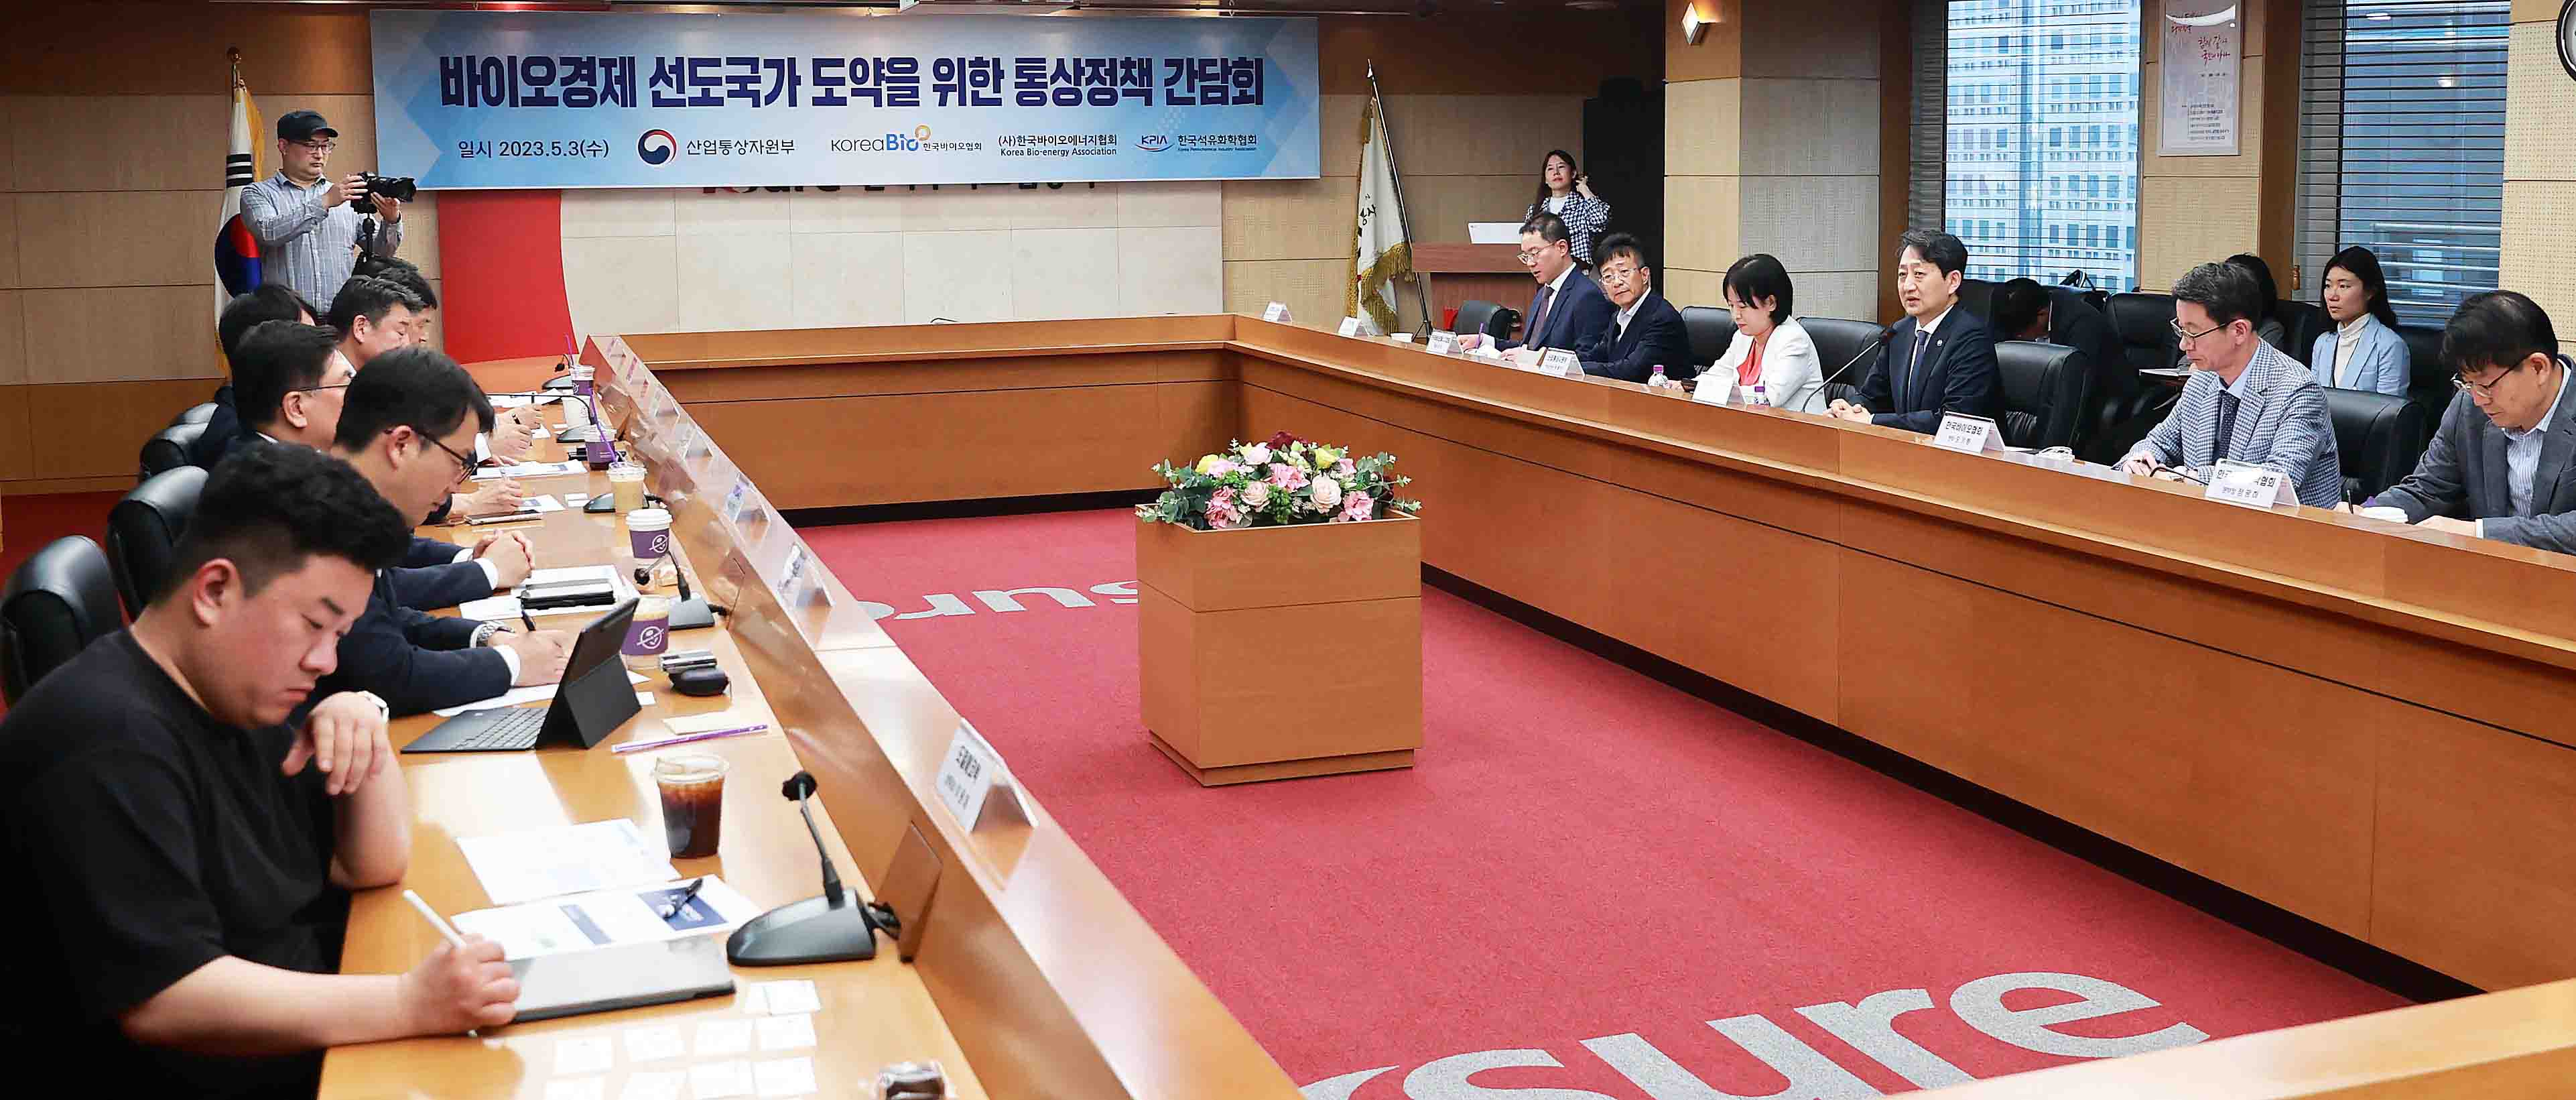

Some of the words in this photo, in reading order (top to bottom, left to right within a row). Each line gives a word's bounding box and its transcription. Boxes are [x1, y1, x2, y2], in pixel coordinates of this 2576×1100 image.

[440, 56, 637, 108] 바이오경제
[649, 56, 801, 108] 선도국가
[812, 56, 920, 107] 도약을
[931, 57, 1005, 107] 위한
[1015, 58, 1153, 107] 통상정책
[1164, 58, 1264, 106] 간담회
[923, 141, 982, 151] 한국바이오협회
[998, 134, 1118, 147] (사)한국바이오에너지협회
[1141, 135, 1168, 145] KPIA
[1177, 134, 1257, 146] 한국석유화학협회
[458, 139, 493, 158] 일시
[499, 139, 610, 158] 2023.5.3(수)
[686, 139, 796, 156] 산업통상자원부
[1001, 147, 1025, 156] Korea
[1027, 147, 1070, 158] Bio-energy
[1072, 147, 1117, 156] Association
[1298, 971, 2211, 1100] sure
